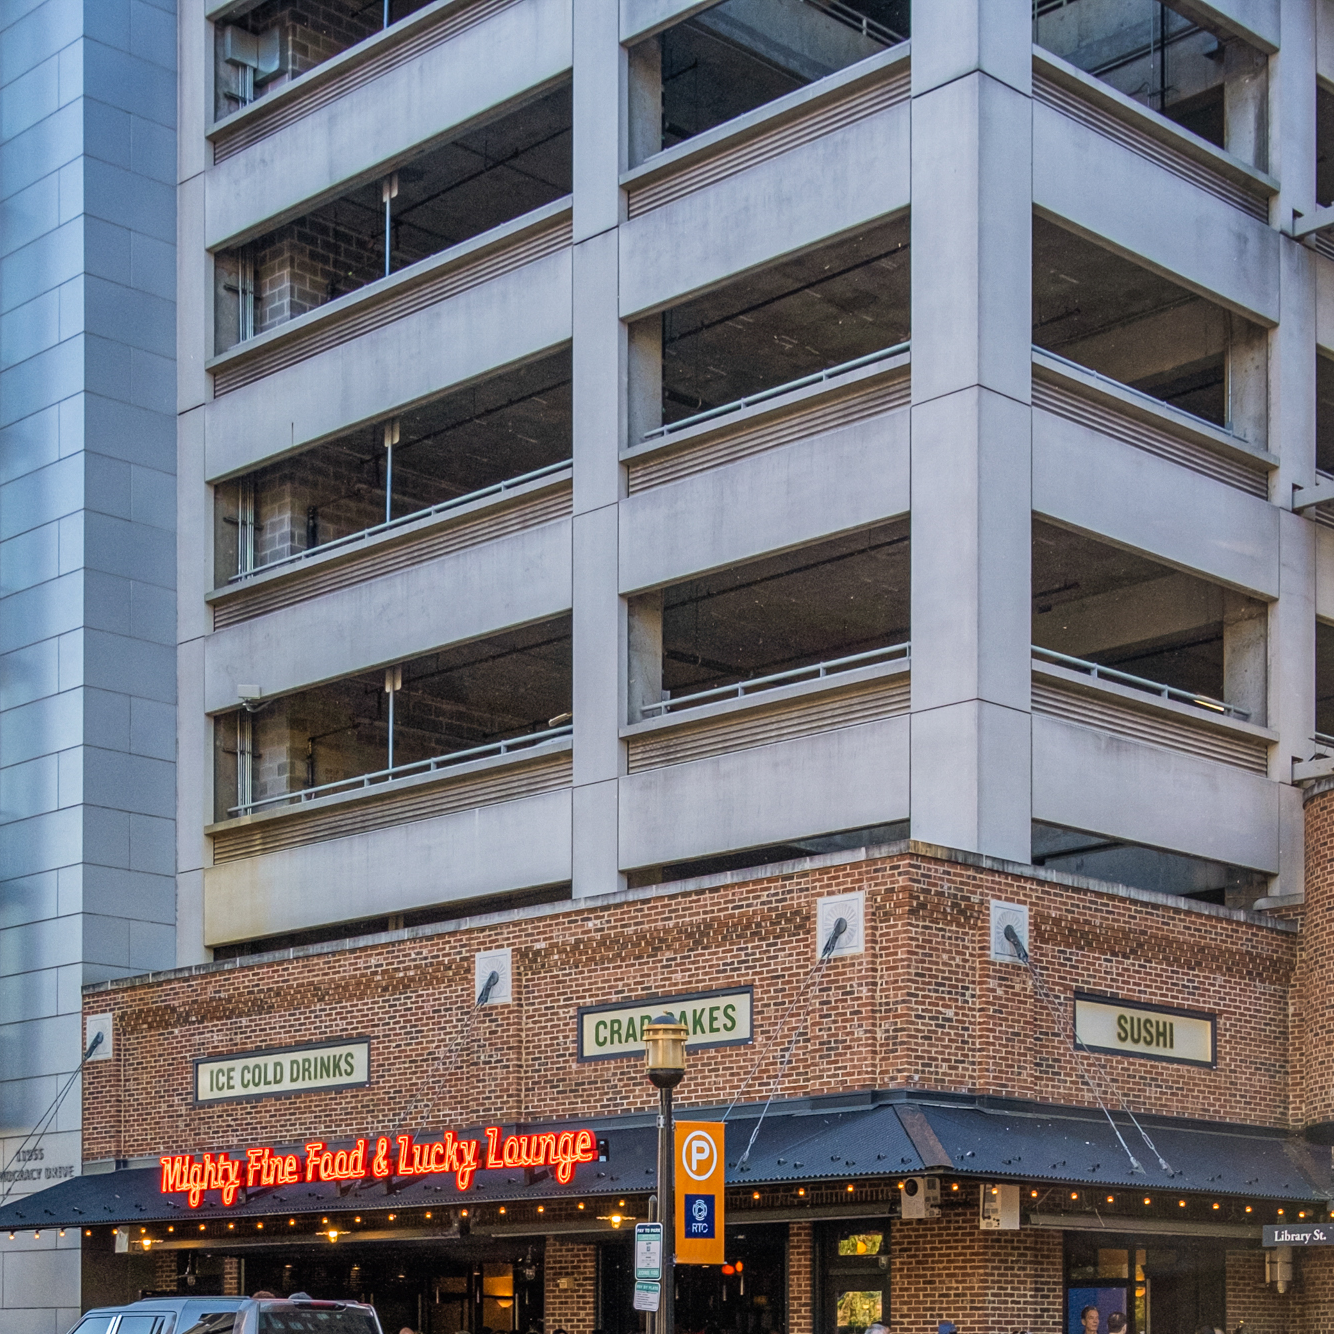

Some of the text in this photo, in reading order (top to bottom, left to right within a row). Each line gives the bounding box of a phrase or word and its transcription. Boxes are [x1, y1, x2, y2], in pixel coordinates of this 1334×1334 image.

[666, 1003, 737, 1036] AKES
[1117, 1014, 1174, 1049] SUSHI
[209, 1052, 355, 1092] ICE COLD DRINKS
[160, 1126, 596, 1209] Mighty Fine Food & Lucky Lounge
[691, 1140, 710, 1171] P
[44, 1165, 75, 1180] DRIVE
[691, 1222, 708, 1233] RTC
[1274, 1229, 1327, 1244] Library St.
